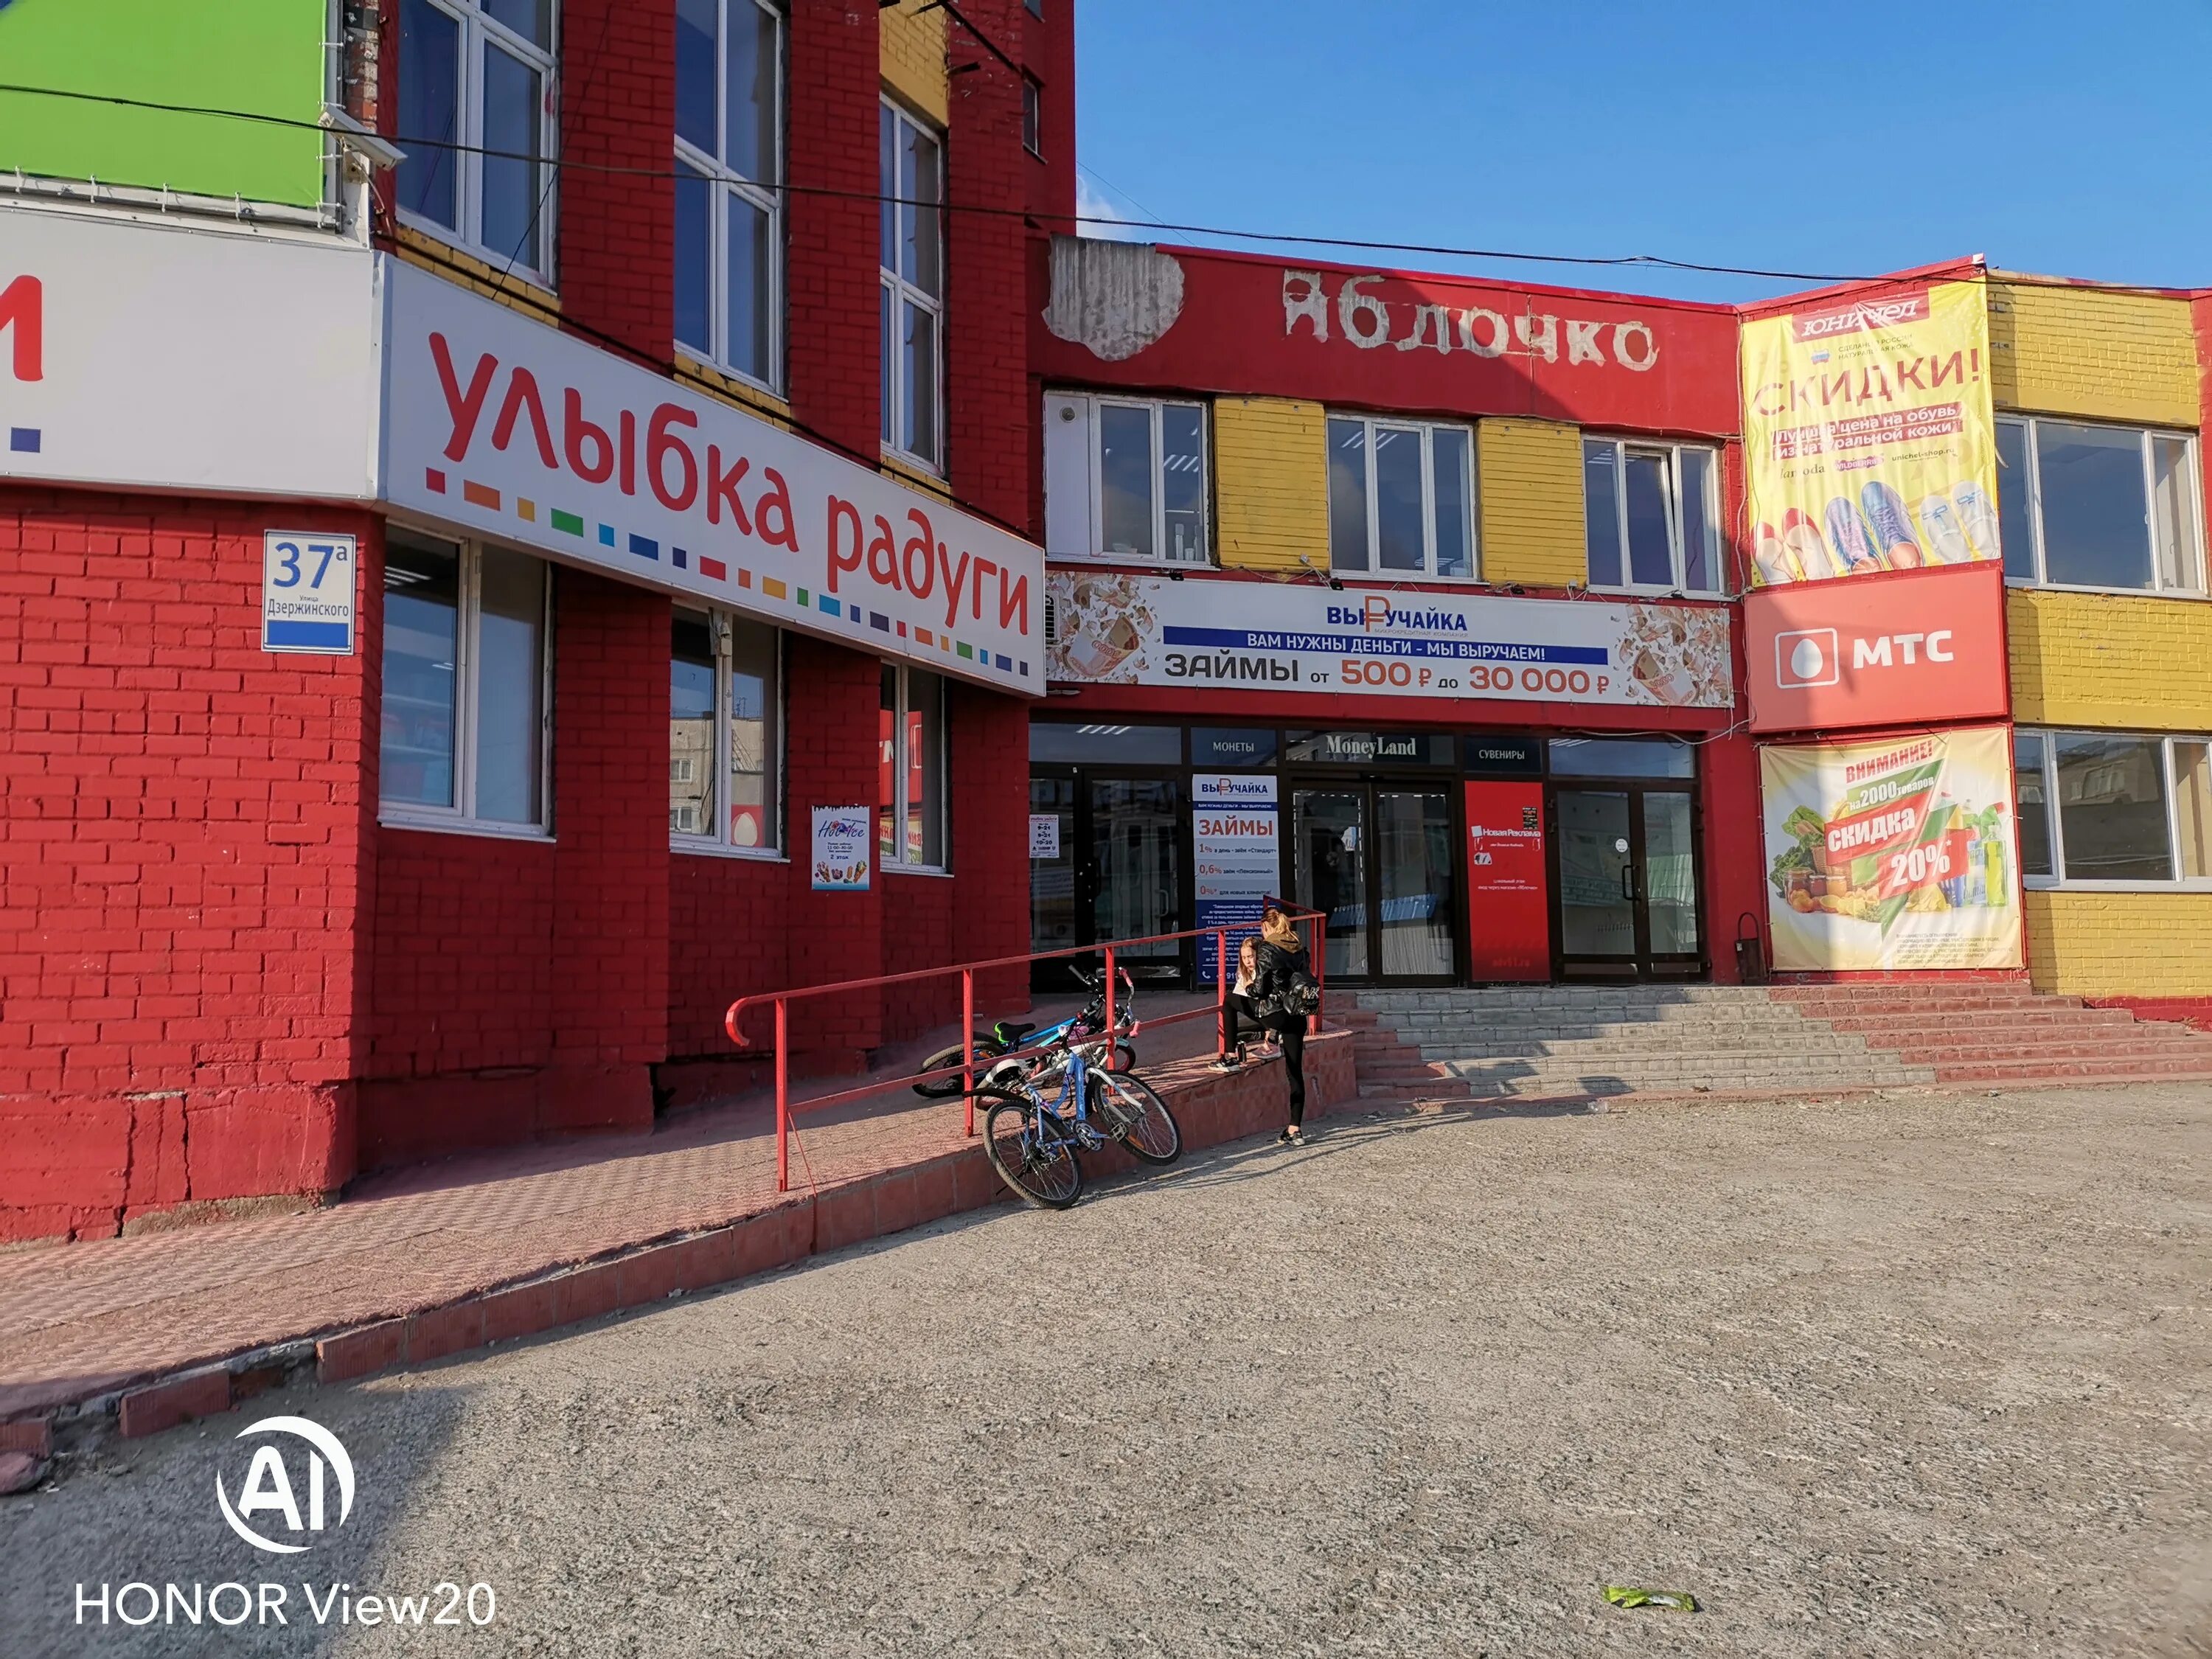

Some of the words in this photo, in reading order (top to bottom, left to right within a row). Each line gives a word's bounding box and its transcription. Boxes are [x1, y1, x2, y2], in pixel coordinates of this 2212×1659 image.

[1282, 269, 1659, 371] Яблочко
[1838, 347, 1891, 360] НАТУРАЛЬАЯ
[1754, 348, 1979, 416] СКИДКИ!
[1841, 417, 1879, 434] цена
[1883, 414, 1902, 425] на
[1907, 405, 1957, 422] обувь
[827, 495, 1028, 636] радуги
[268, 598, 349, 618] Дзержинского
[1248, 633, 1281, 647] ВАМ
[1287, 636, 1346, 651] НУЖНЫ
[1351, 639, 1412, 654] ДЕНЬГИ
[1427, 641, 1454, 656] МЫ
[1458, 644, 1545, 661] ВЫРУЧАЕМ!
[1854, 630, 1954, 669] МТС
[1165, 649, 1298, 681] ЗАЙМЫ
[1341, 659, 1411, 687] 500
[1213, 741, 1254, 752] МОНЕТЫ
[1478, 749, 1525, 760] СУВЕНИРЫ
[1846, 740, 1933, 784] ВНИМАНИЕ!
[1849, 801, 1862, 811] на
[1860, 781, 1897, 807] 2000
[1199, 815, 1273, 836] ЗАЙМЫ
[1483, 829, 1507, 837] Новая
[1508, 829, 1541, 838] Реклама
[1199, 844, 1212, 853] 1%
[1199, 864, 1222, 875] 0,6%
